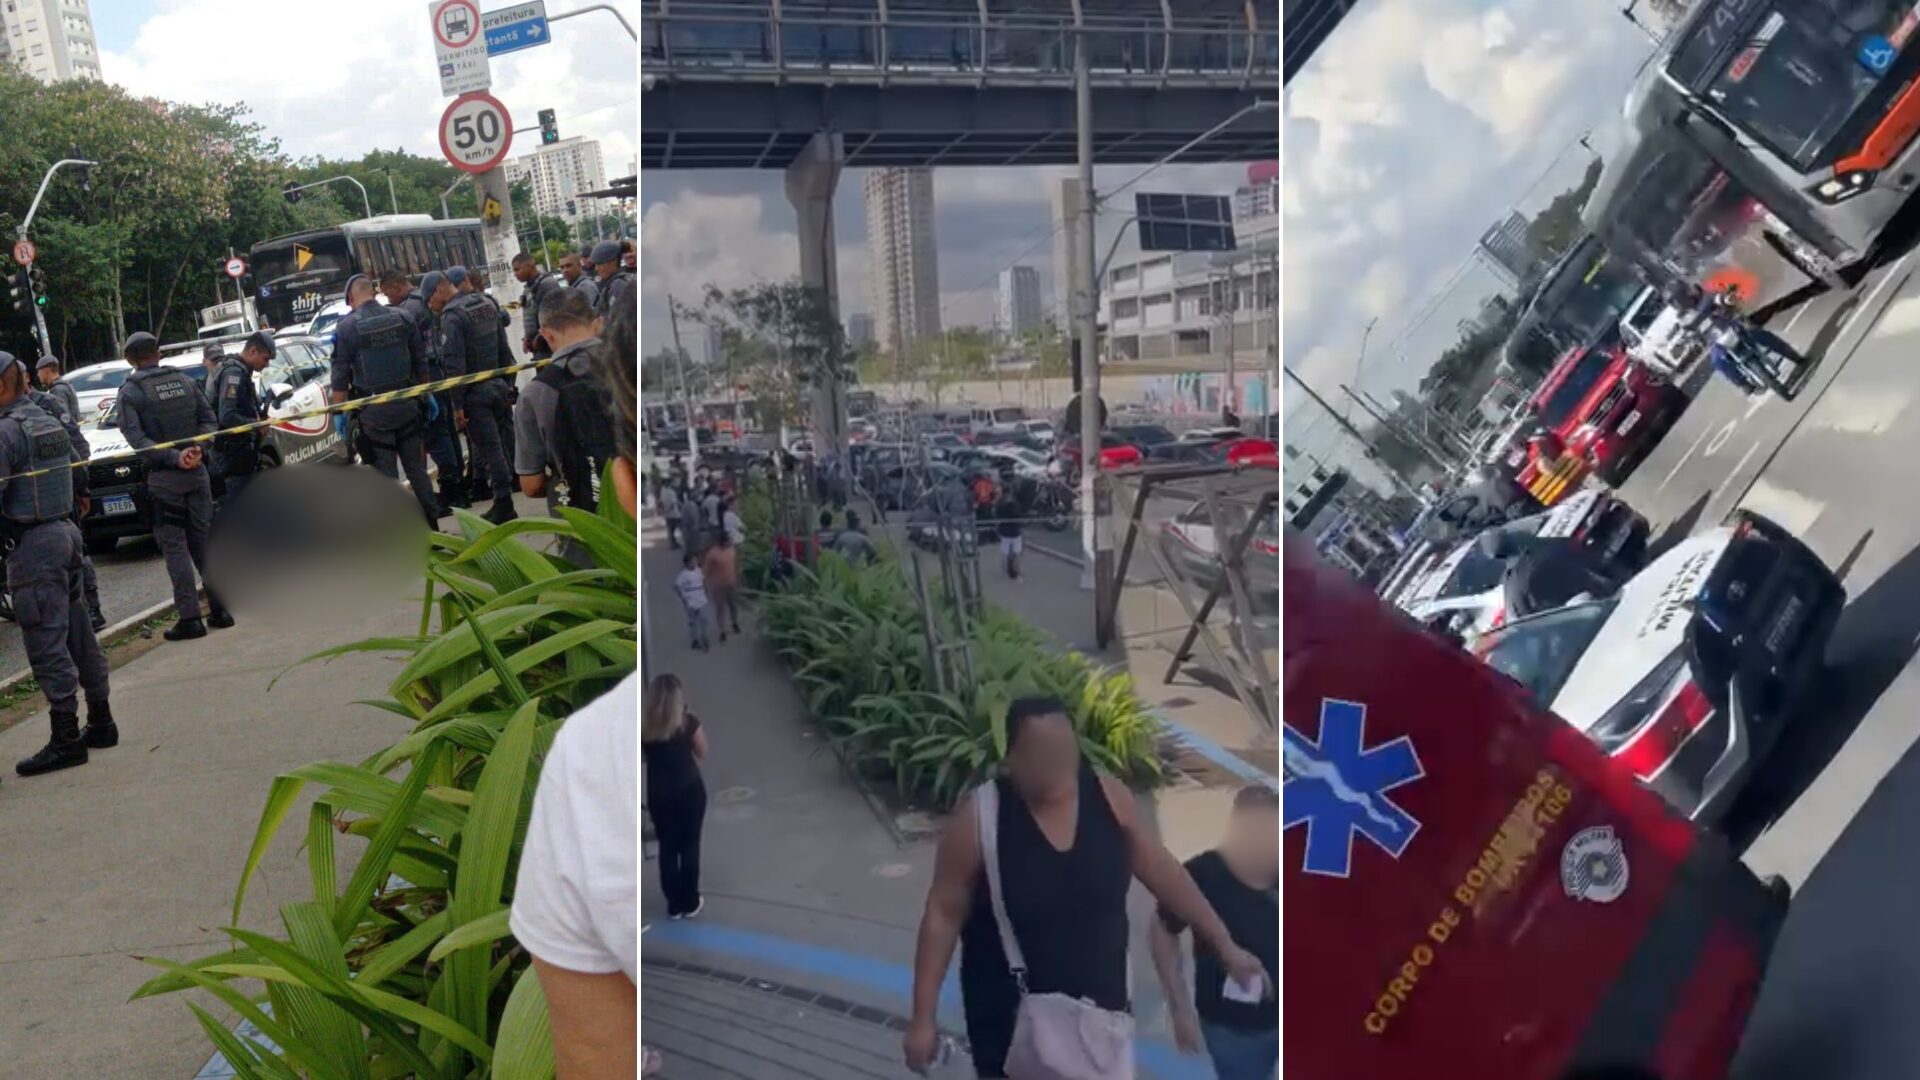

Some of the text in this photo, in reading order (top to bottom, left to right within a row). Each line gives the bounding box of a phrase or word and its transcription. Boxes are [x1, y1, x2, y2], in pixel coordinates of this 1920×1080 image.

[482, 8, 535, 29] prefeitura
[439, 46, 486, 62] PERMITIDO
[453, 109, 499, 149] 50
[464, 146, 494, 160] km/h
[292, 292, 322, 311] shift
[284, 431, 344, 465] POLÍCIA MILITA
[1364, 944, 1434, 1034] CORPO
[1428, 906, 1461, 943] DE
